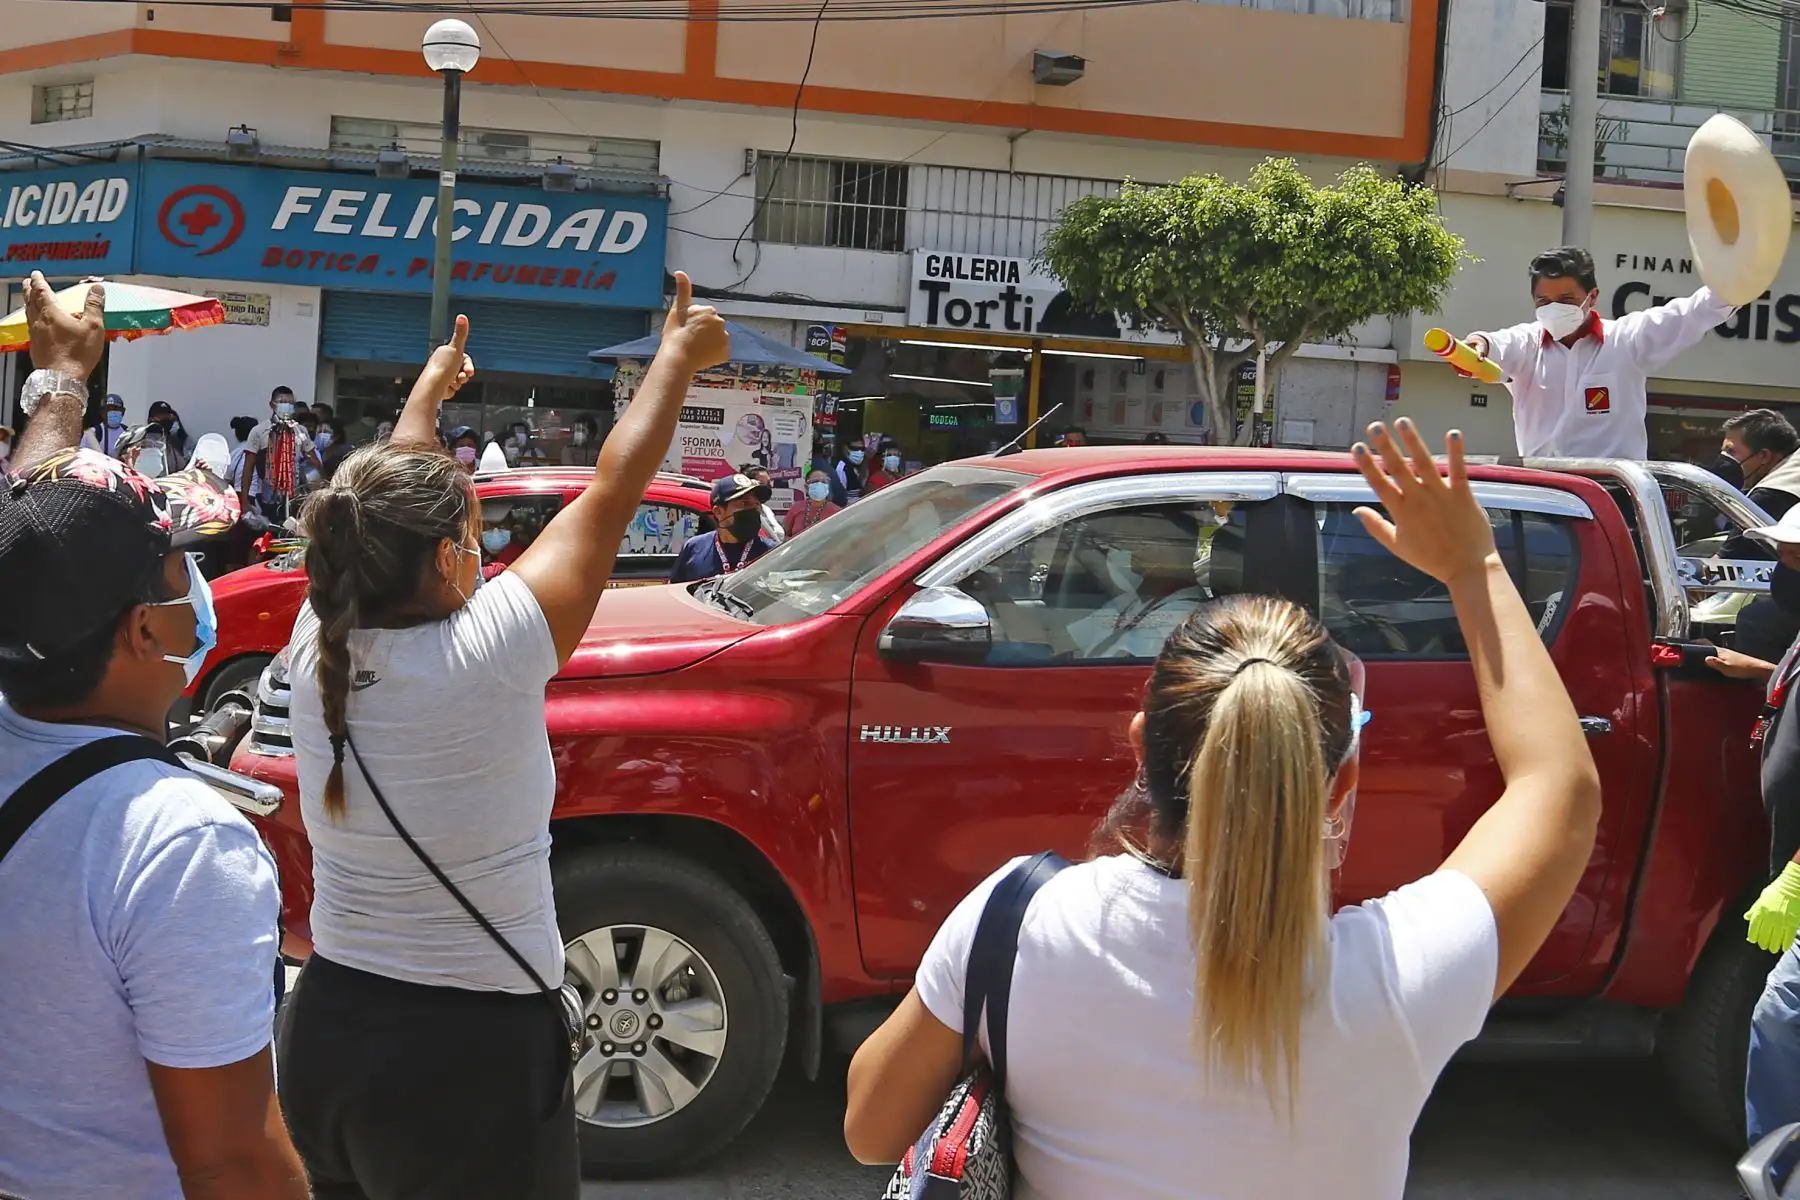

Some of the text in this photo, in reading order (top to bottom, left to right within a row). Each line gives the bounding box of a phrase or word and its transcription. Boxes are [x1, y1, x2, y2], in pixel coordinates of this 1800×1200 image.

[0, 178, 129, 228] ICIDAD
[271, 186, 648, 254] FELICIDAD
[261, 246, 380, 273] BOTICA
[926, 254, 1020, 284] GALERIA
[1615, 253, 1693, 274] FINAN
[919, 279, 1034, 333] Torti
[929, 414, 958, 426] BODEGA
[681, 436, 721, 448] SFORMA
[684, 446, 725, 458] FUTURO
[860, 724, 952, 744] HILUX
